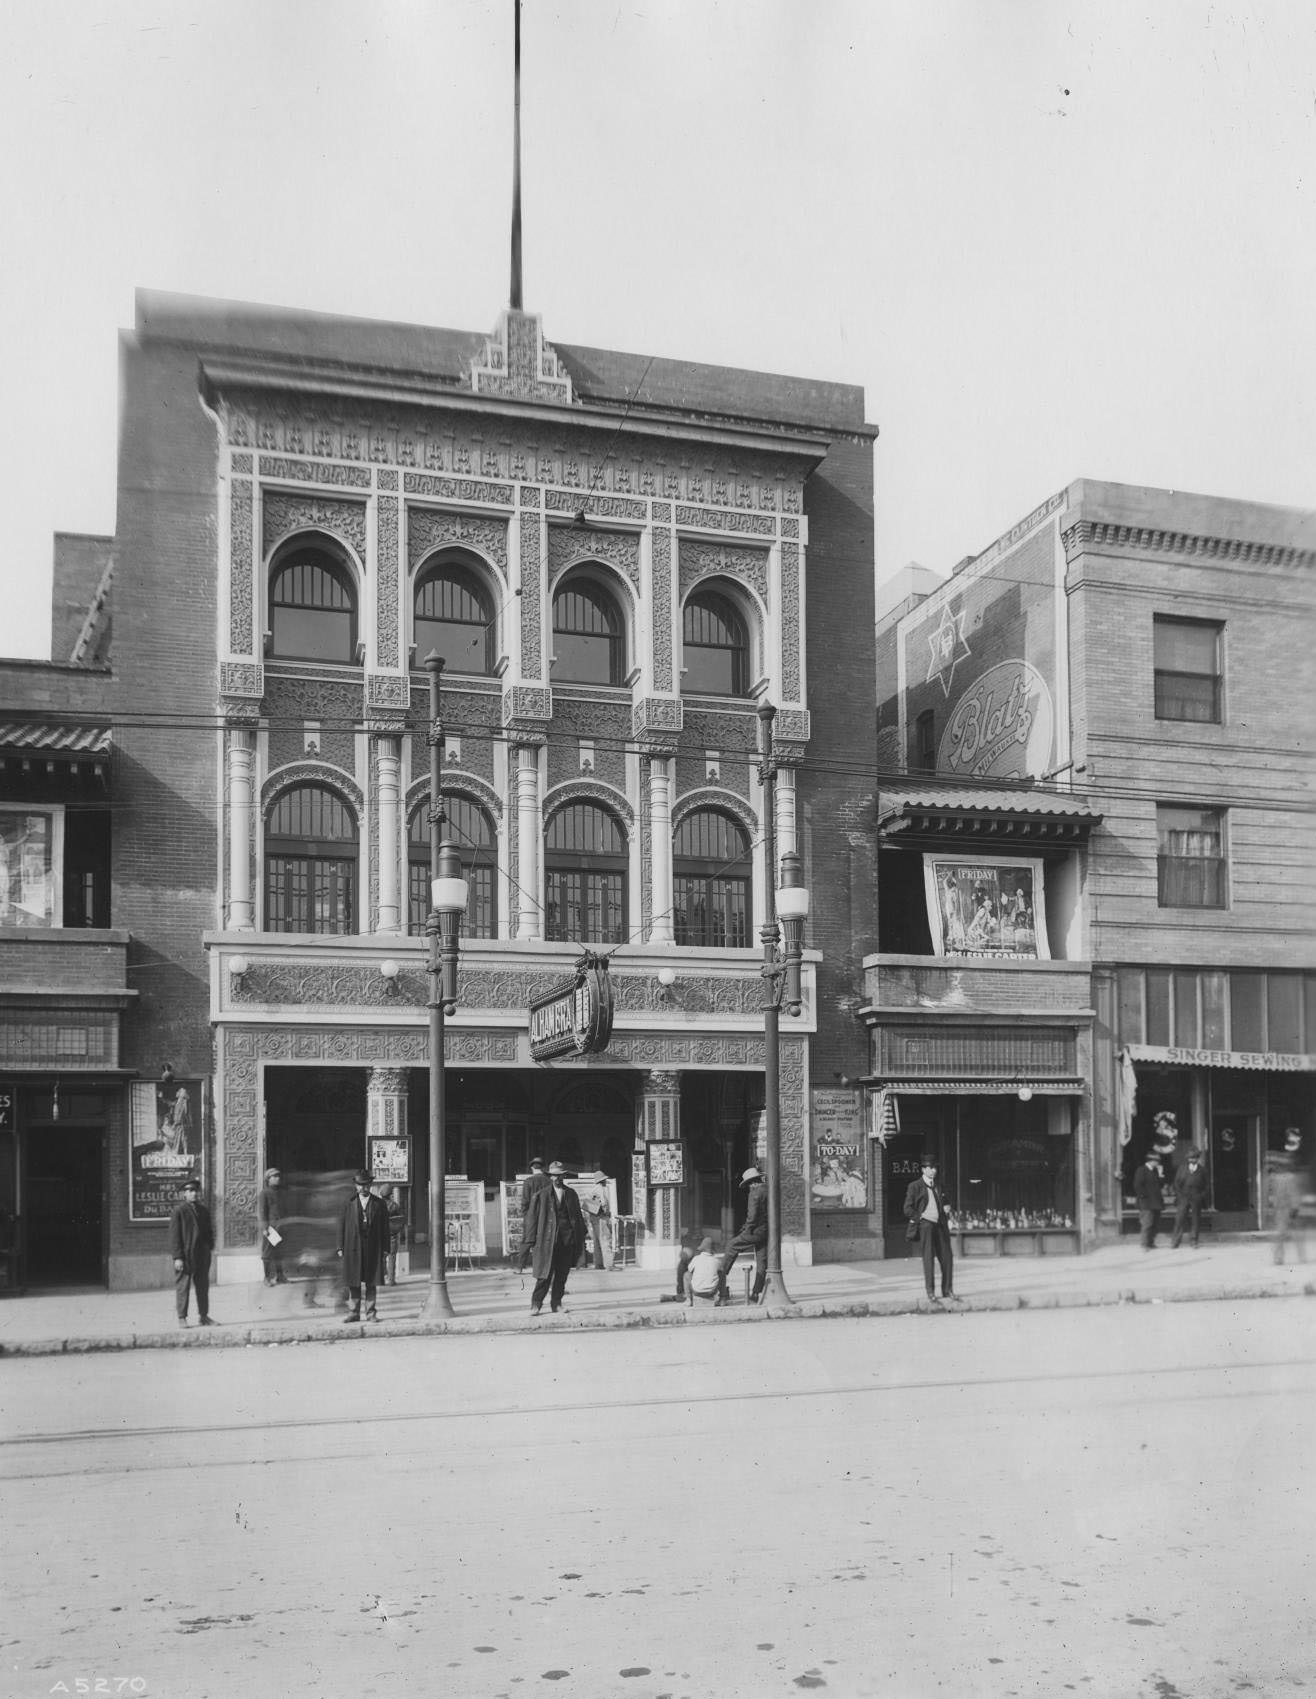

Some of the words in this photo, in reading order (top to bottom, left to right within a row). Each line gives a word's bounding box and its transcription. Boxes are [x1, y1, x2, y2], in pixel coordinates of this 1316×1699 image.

[948, 672, 1034, 765] Blatz
[961, 869, 994, 880] FRIDAY
[530, 998, 572, 1044] ALHAMBRA
[1167, 1048, 1232, 1064] SINGER
[1239, 1053, 1301, 1068] SEWING
[1153, 1110, 1179, 1154] S
[1221, 1128, 1235, 1151] S
[1284, 1127, 1301, 1151] S
[820, 1146, 856, 1156] TO-DAY
[145, 1155, 190, 1168] FRIDAY
[892, 1160, 920, 1174] BAR
[135, 1191, 167, 1202] LESLIE
